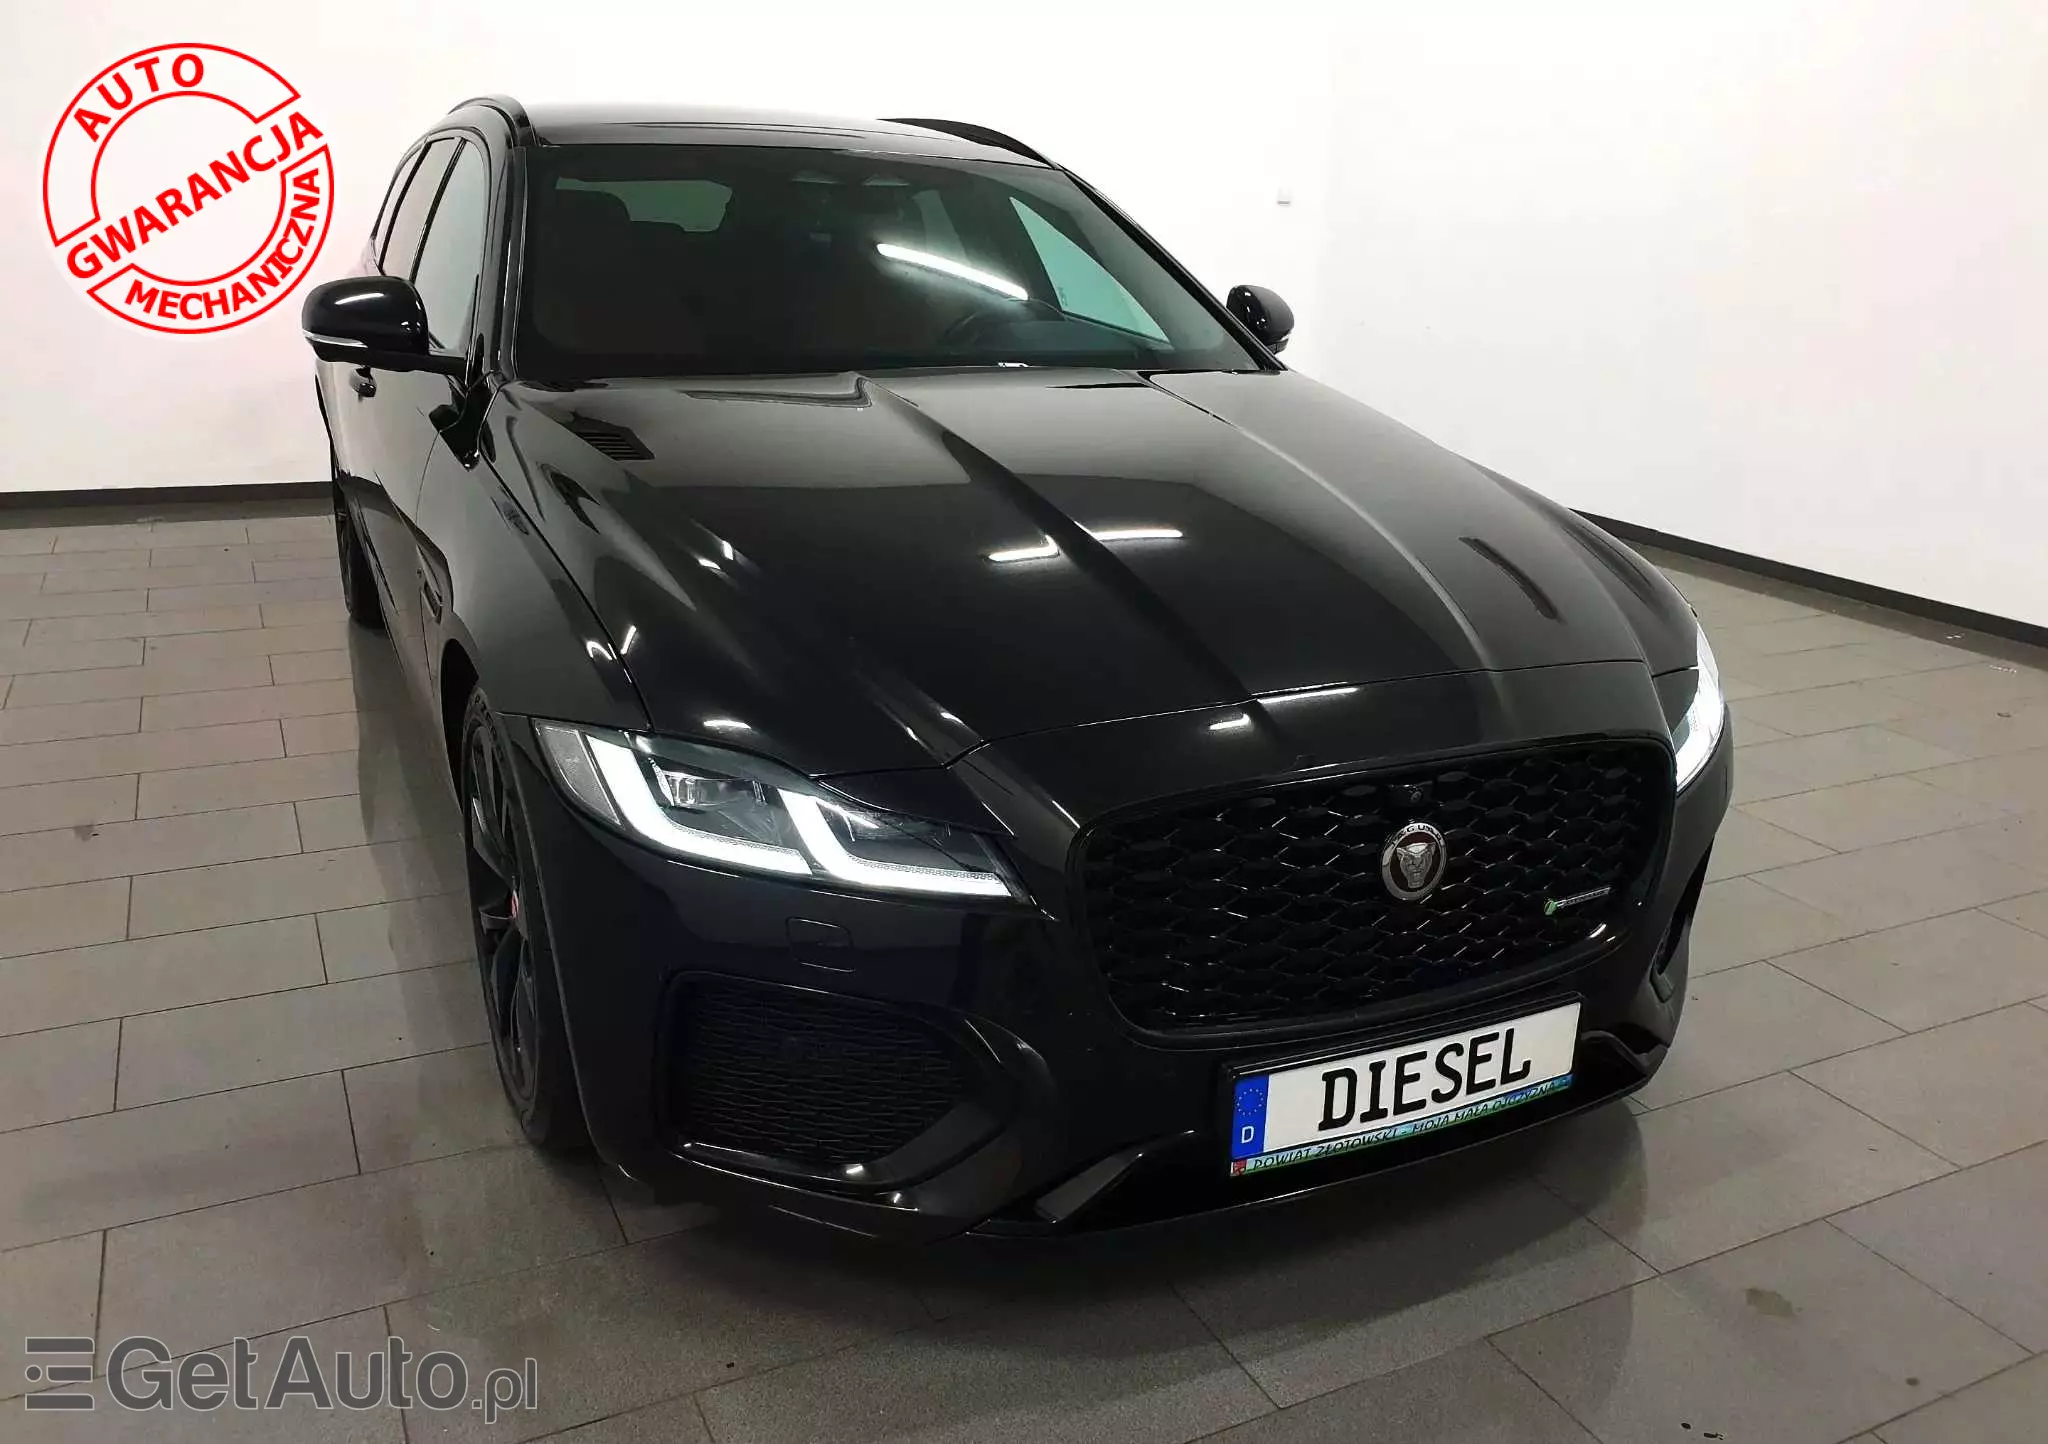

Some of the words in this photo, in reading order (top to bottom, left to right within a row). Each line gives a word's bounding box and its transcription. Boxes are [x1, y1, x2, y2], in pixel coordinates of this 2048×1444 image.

[1317, 1028, 1532, 1132] DIESEL
[1241, 1126, 1255, 1144] D
[1253, 1148, 1311, 1170] POWIAT
[1412, 1114, 1450, 1134] MOJA
